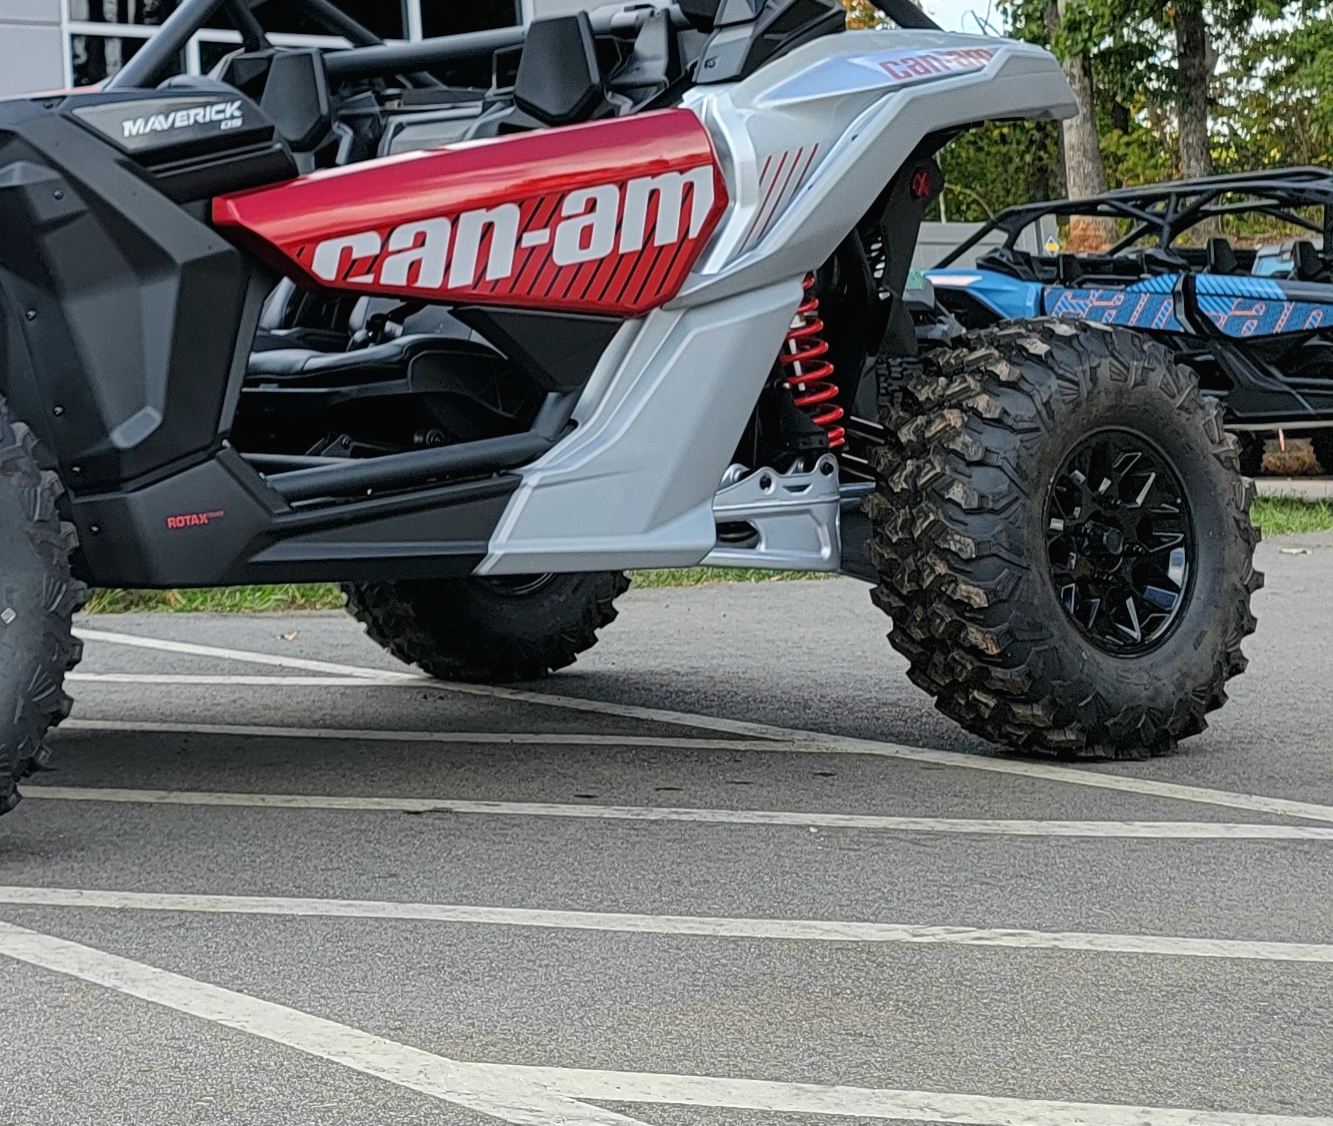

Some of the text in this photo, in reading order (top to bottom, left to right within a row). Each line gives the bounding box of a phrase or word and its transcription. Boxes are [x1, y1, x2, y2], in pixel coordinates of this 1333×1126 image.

[122, 100, 243, 137] MAVERICK
[311, 165, 715, 290] can-am
[167, 513, 208, 528] ROTAX
